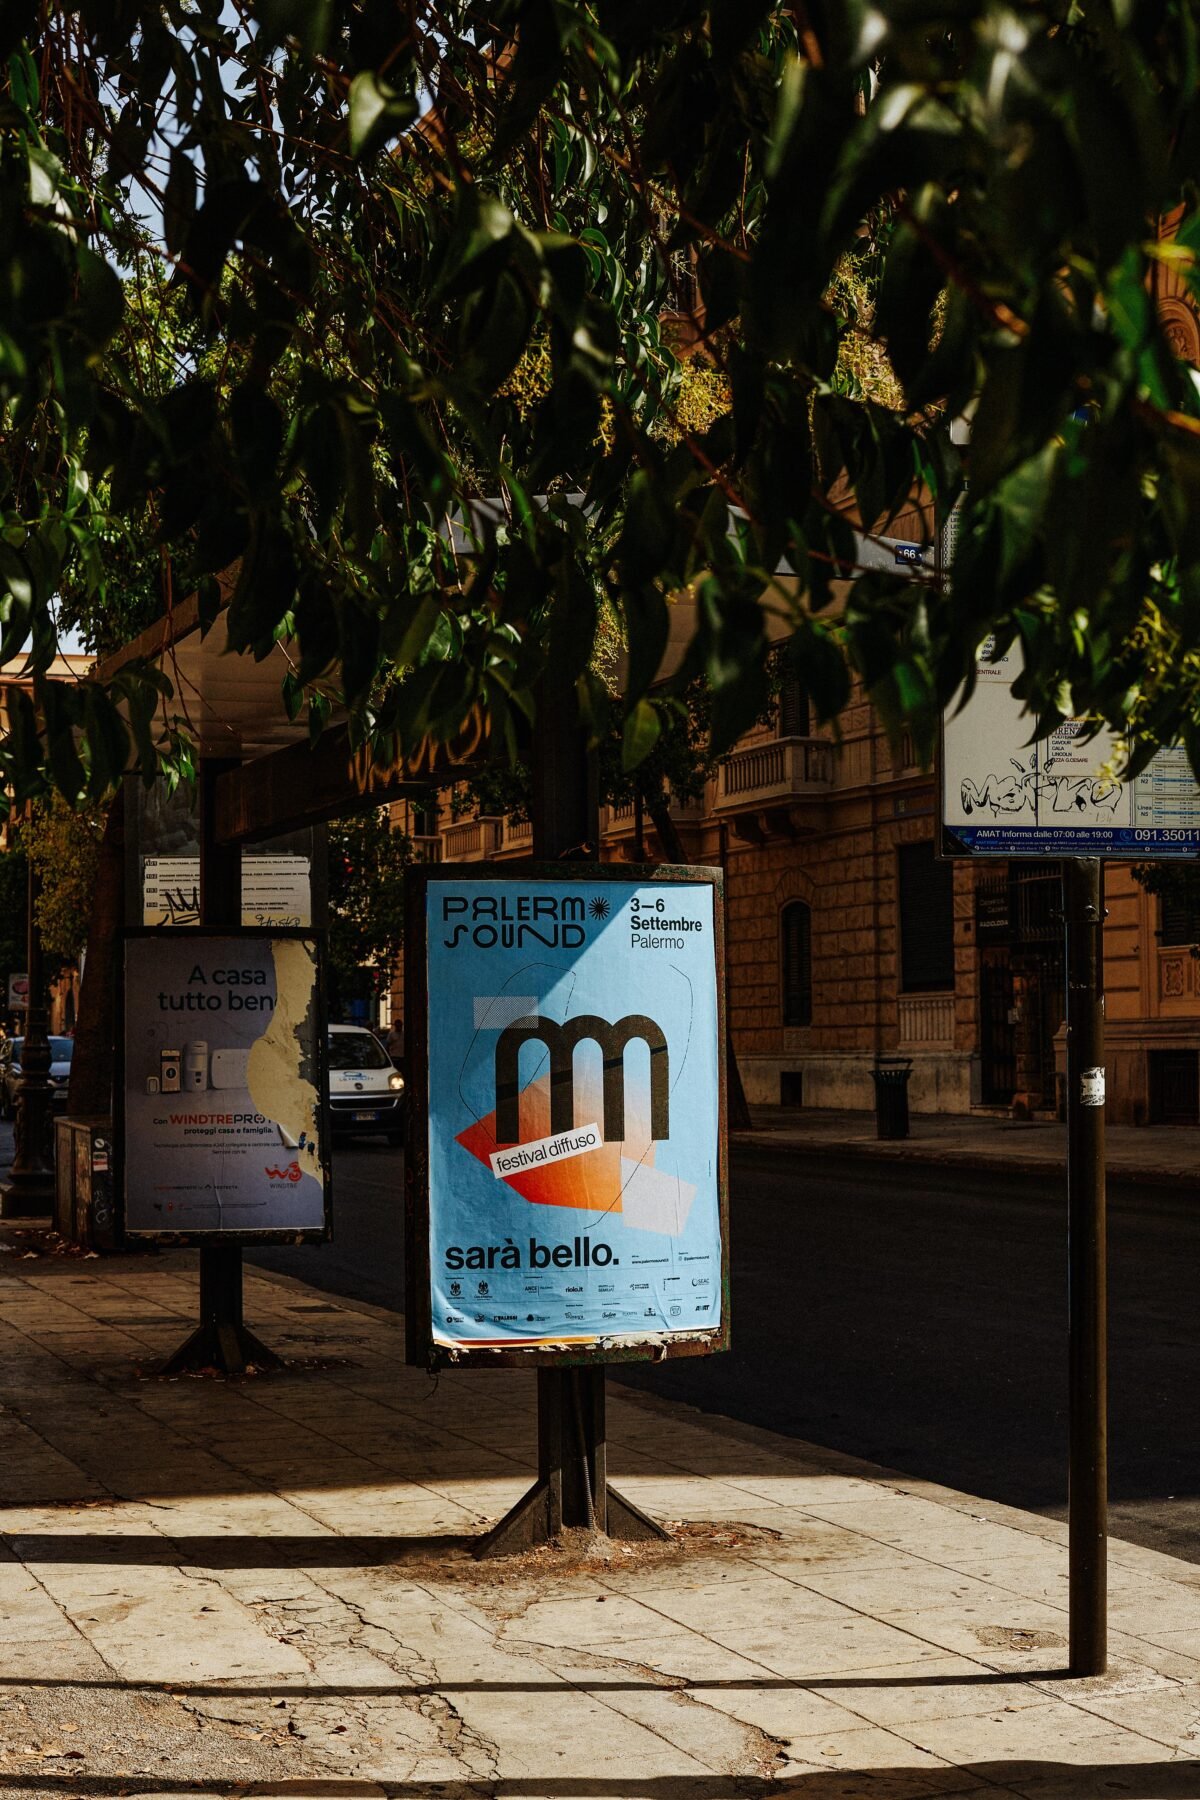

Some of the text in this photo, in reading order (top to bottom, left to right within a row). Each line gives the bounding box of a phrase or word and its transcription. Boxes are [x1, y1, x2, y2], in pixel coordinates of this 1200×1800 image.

[903, 549, 916, 559] 66
[976, 830, 1001, 838] AMAT
[1002, 830, 1032, 838] Informa
[1033, 830, 1053, 838] dalle
[1076, 831, 1090, 839] alle
[1091, 831, 1113, 839] 19:00
[630, 915, 702, 932] Settembre
[444, 924, 586, 949] SOUND
[631, 934, 685, 950] Palermo
[187, 965, 267, 986] A casa
[157, 990, 278, 1012] tutto ben
[184, 1126, 217, 1136] proteggi
[218, 1127, 235, 1135] casa
[243, 1126, 274, 1136] famiglia.
[496, 1131, 597, 1173] festival diffuso
[445, 1236, 619, 1270] sarà bello.
